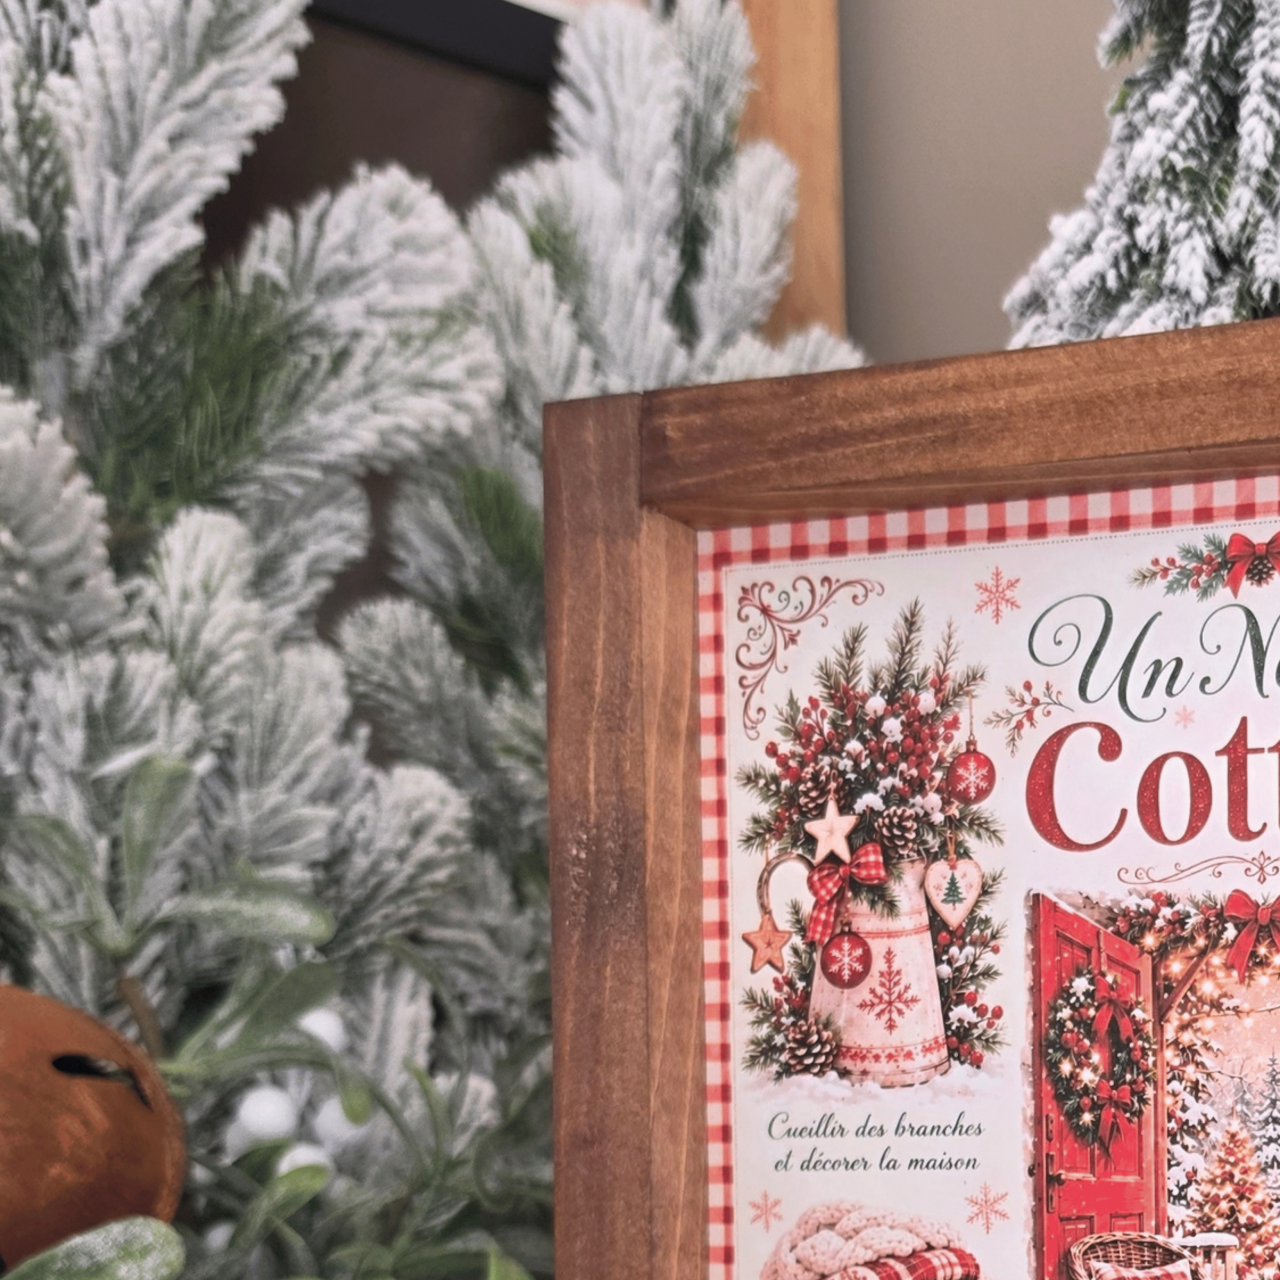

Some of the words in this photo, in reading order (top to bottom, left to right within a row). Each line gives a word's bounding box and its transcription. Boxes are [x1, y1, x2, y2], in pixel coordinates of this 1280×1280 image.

[1027, 593, 1195, 723] Un
[768, 1111, 849, 1140] Cueillir
[855, 1113, 887, 1137] des
[894, 1111, 985, 1137] branches
[774, 1149, 794, 1172] et
[800, 1146, 872, 1171] décorer
[879, 1146, 901, 1171] la
[907, 1152, 981, 1170] maison
